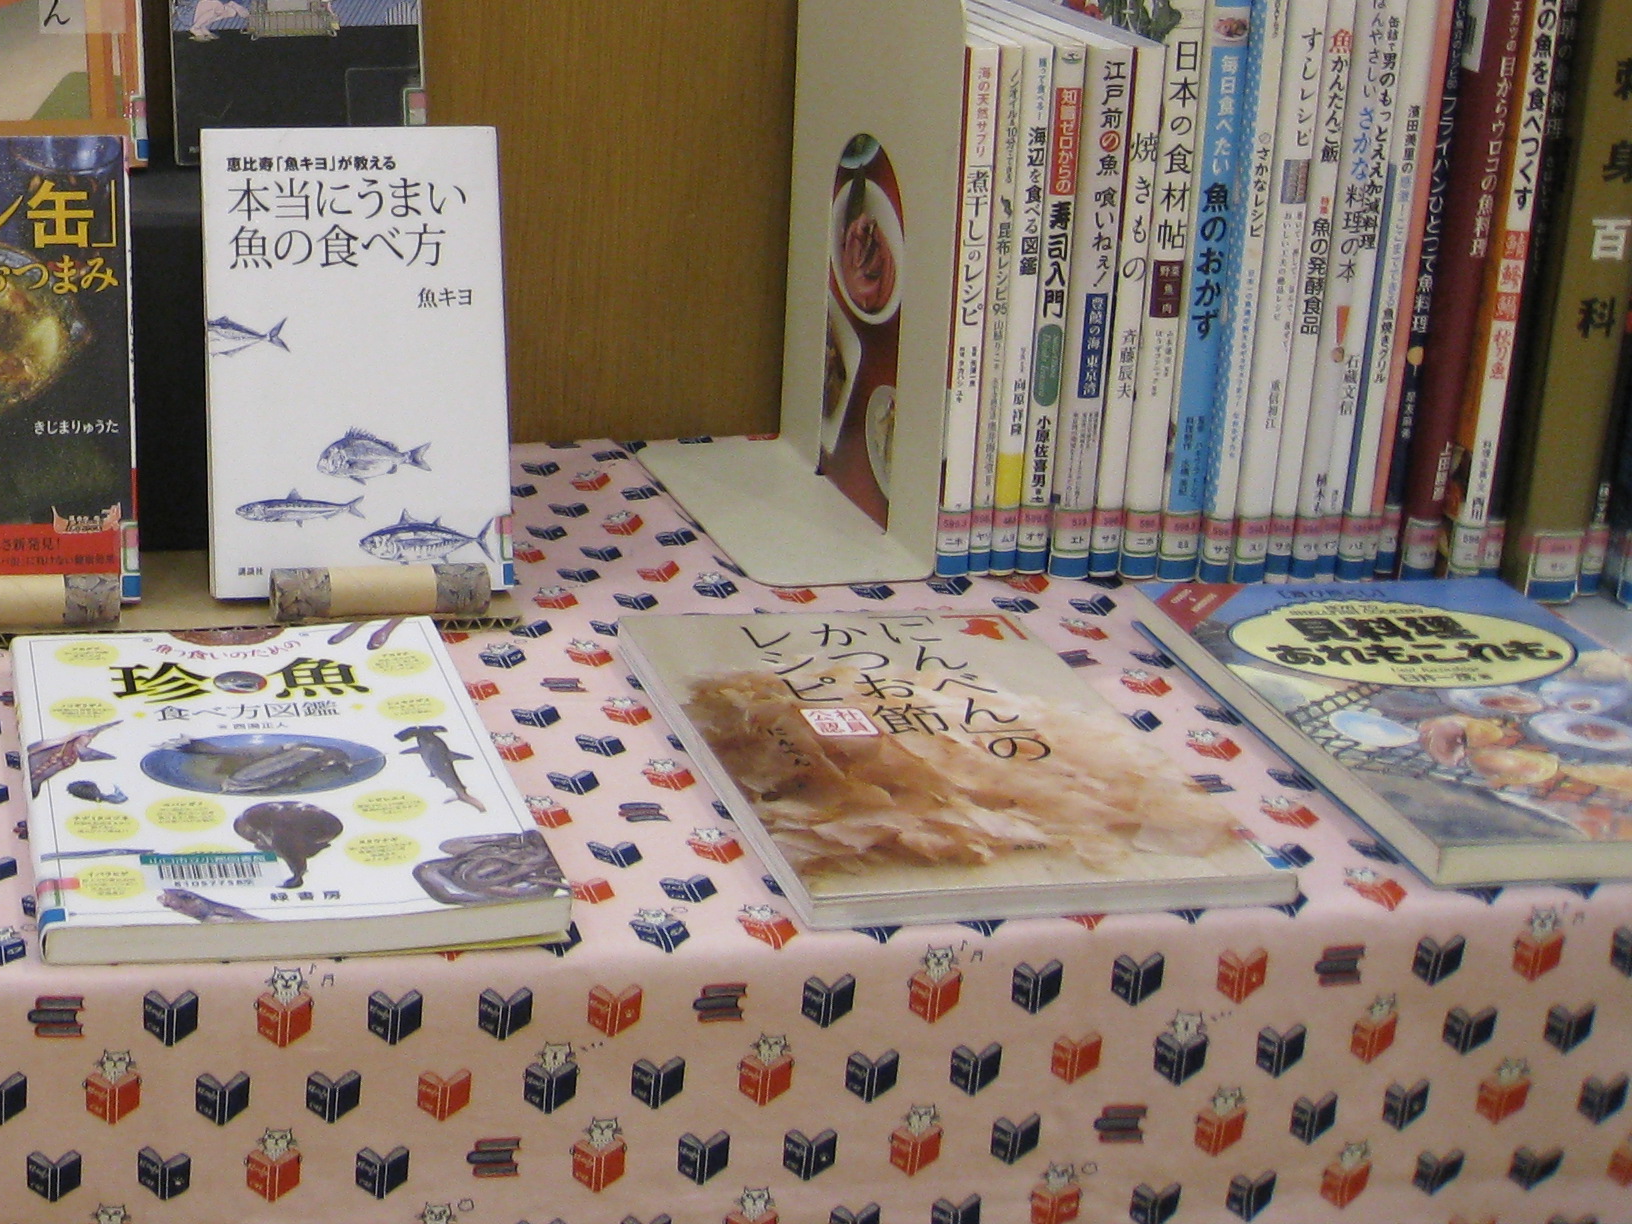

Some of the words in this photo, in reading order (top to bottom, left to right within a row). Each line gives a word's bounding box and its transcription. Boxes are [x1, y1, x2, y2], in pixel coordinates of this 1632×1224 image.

[1050, 88, 1079, 194] 知識ゼロからの
[1096, 60, 1128, 177] 江戸前の魚
[1157, 40, 1199, 252] 日本の食材帖
[1320, 28, 1354, 163] 魚かんたんご飯
[226, 155, 397, 173] 恵比寿「魚キヨ」が教える
[227, 177, 467, 222] 本当にうまい
[1018, 126, 1048, 276] 海辺を食べる図鑑
[1121, 131, 1159, 282] 焼きもの
[1469, 56, 1517, 258] 目からウロコの魚料理
[228, 223, 447, 270] 魚の食べ方
[416, 287, 474, 309] 魚キヨ
[1042, 201, 1072, 319] 寿司入門
[1191, 180, 1230, 341] 魚のおかず
[1300, 217, 1331, 336] 魚の発酵食品
[33, 418, 120, 436] きじまりゅうた
[739, 625, 844, 702] レシピ
[810, 622, 950, 736] かつお節
[1266, 640, 1566, 666] あれもこれも
[1285, 615, 1479, 643] 貝料理
[154, 700, 341, 724] 食べ方図鑑
